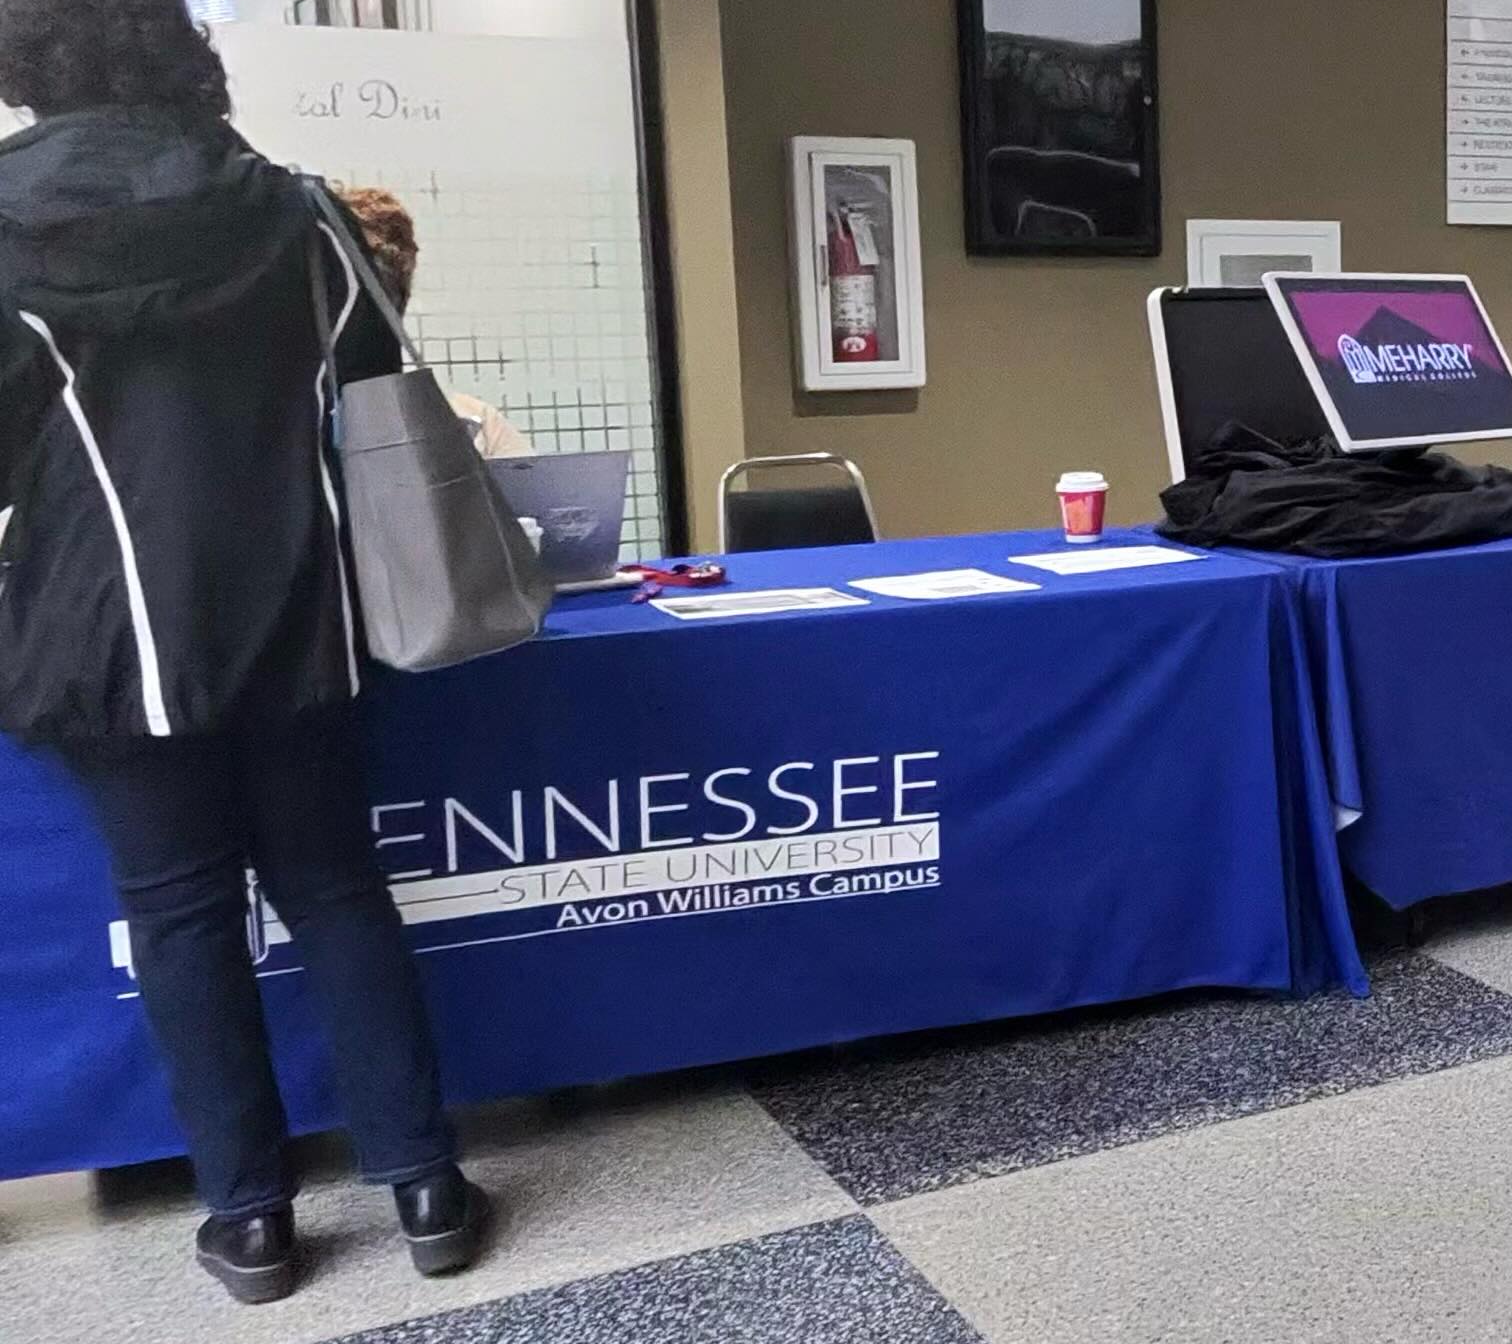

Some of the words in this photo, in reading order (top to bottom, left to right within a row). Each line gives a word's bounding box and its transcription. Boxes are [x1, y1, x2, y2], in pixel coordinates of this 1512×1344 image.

[1363, 343, 1473, 372] MEHARRY
[371, 751, 940, 880] ENNESSEE
[500, 859, 649, 905] STATE
[666, 827, 934, 883] UNIVERSITY
[556, 899, 648, 929] Avon
[656, 880, 800, 914] Williams
[808, 865, 940, 894] Campus
